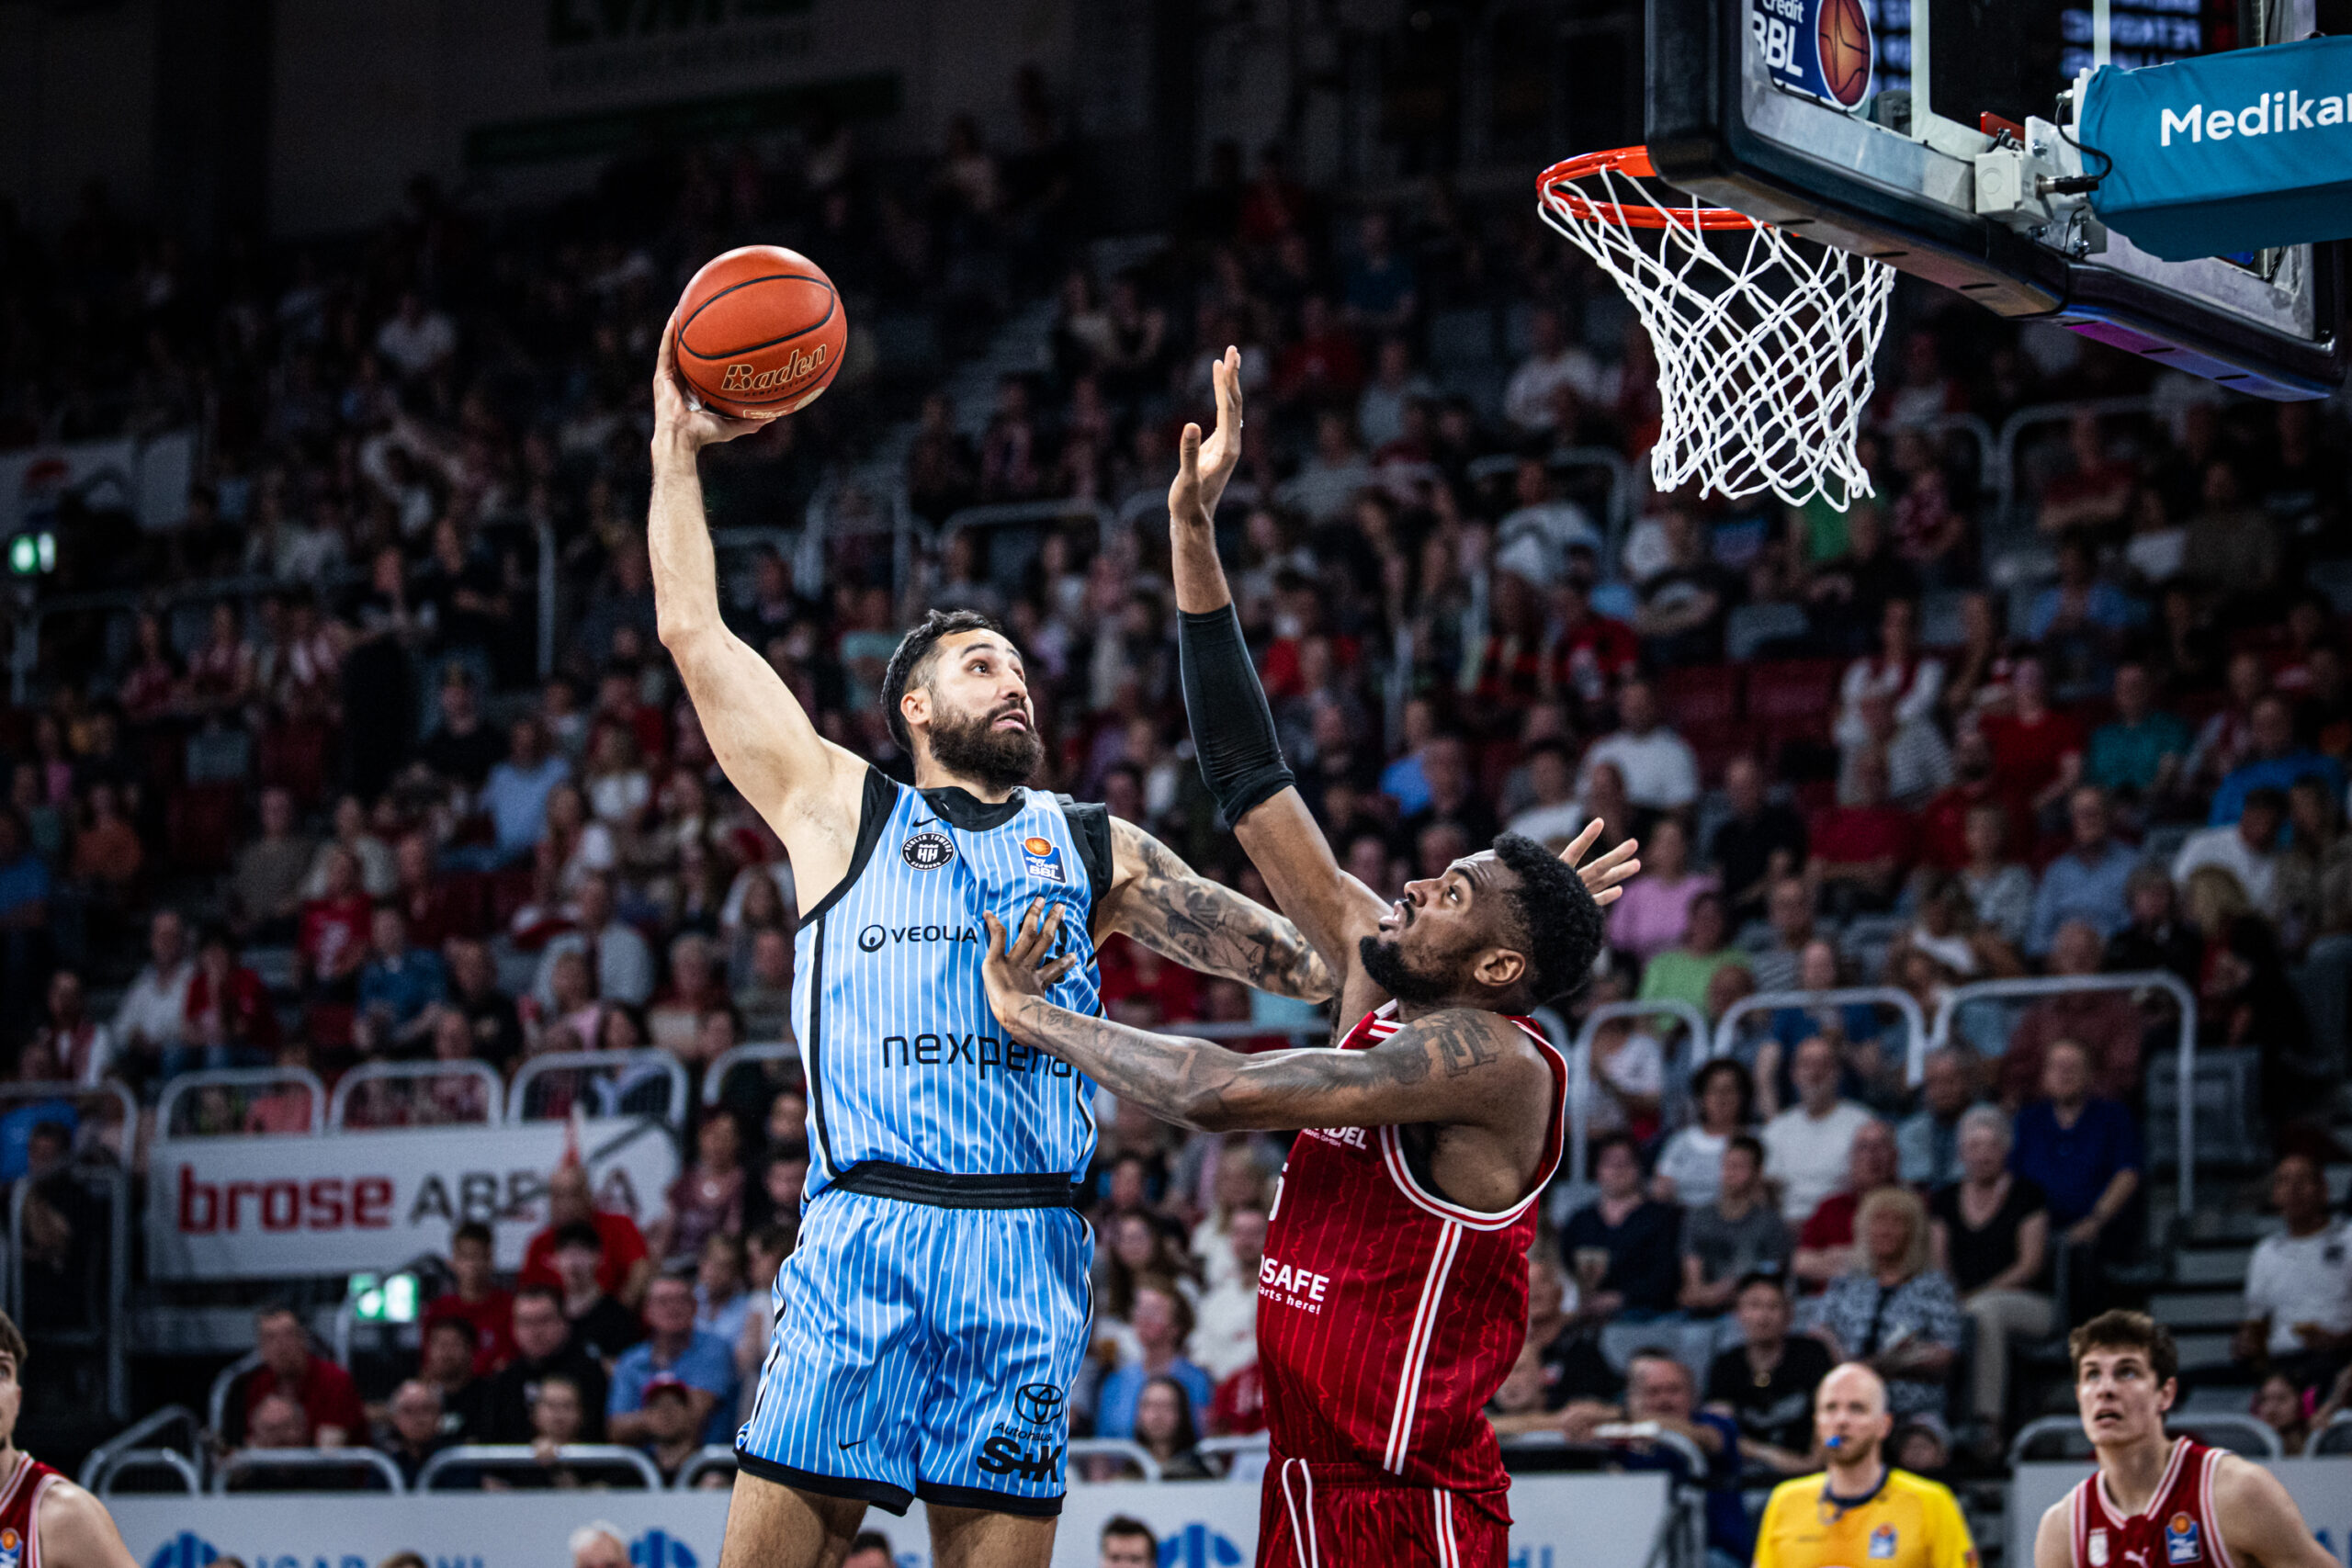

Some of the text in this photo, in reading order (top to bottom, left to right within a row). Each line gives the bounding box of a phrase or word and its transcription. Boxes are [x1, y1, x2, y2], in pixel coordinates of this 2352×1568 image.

[2161, 90, 2352, 147] Medika
[721, 344, 827, 390] Baden
[1030, 865, 1061, 880] BBL
[891, 925, 978, 943] VEOLIA
[179, 1162, 394, 1235] brose
[1259, 1254, 1329, 1303] SAFE
[1258, 1283, 1321, 1314] arts here!
[993, 1422, 1053, 1442] Autohaus
